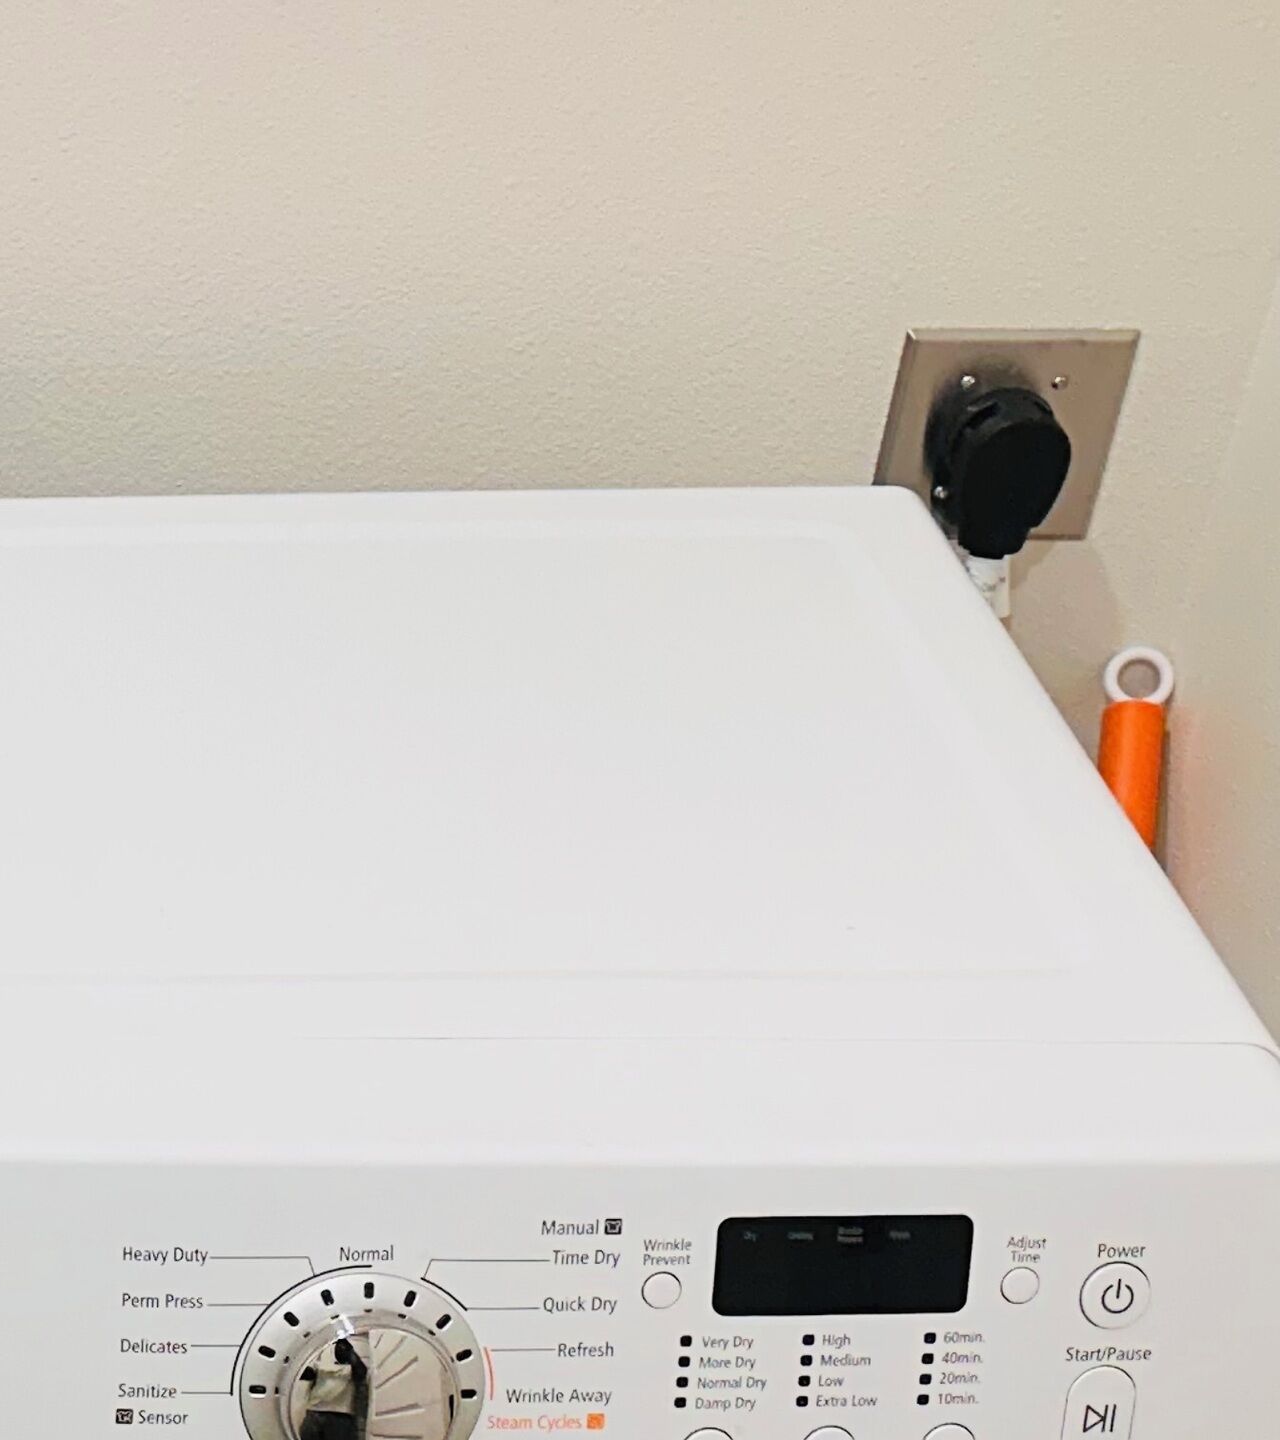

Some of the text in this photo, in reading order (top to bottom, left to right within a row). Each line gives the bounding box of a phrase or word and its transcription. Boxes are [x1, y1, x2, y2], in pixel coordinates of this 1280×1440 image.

[541, 1219, 599, 1235] Manual
[644, 1238, 692, 1251] Wrinkle
[1007, 1237, 1047, 1252] Adjust
[1097, 1243, 1146, 1258] Power
[123, 1246, 208, 1266] Heavy Duty
[339, 1245, 394, 1262] Normal
[553, 1249, 621, 1268] Time Dry
[643, 1254, 690, 1265] Prevent
[1011, 1250, 1040, 1263] Time
[122, 1293, 203, 1309] Perm Press
[543, 1296, 617, 1315] Quick Dry
[702, 1336, 754, 1351] Very Dry
[822, 1334, 851, 1349] High
[944, 1332, 984, 1343] 60min.
[120, 1339, 187, 1354] Delicates
[558, 1341, 614, 1357] Refresh
[820, 1354, 871, 1367] Medium
[942, 1352, 982, 1364] 40min.
[1065, 1347, 1152, 1362] Start/Pause
[699, 1356, 756, 1371] More Dry
[697, 1376, 767, 1391] Normal Dry
[819, 1375, 844, 1387] Low
[940, 1372, 980, 1384] 20min.
[118, 1383, 177, 1398] Sanitize
[506, 1388, 612, 1406] Wrinkle Away
[695, 1397, 756, 1411] Damp Dry
[816, 1395, 878, 1407] Extra Low
[938, 1393, 978, 1404] 10min.
[138, 1410, 189, 1424] Sensor
[488, 1415, 582, 1430] Steam Cycles
